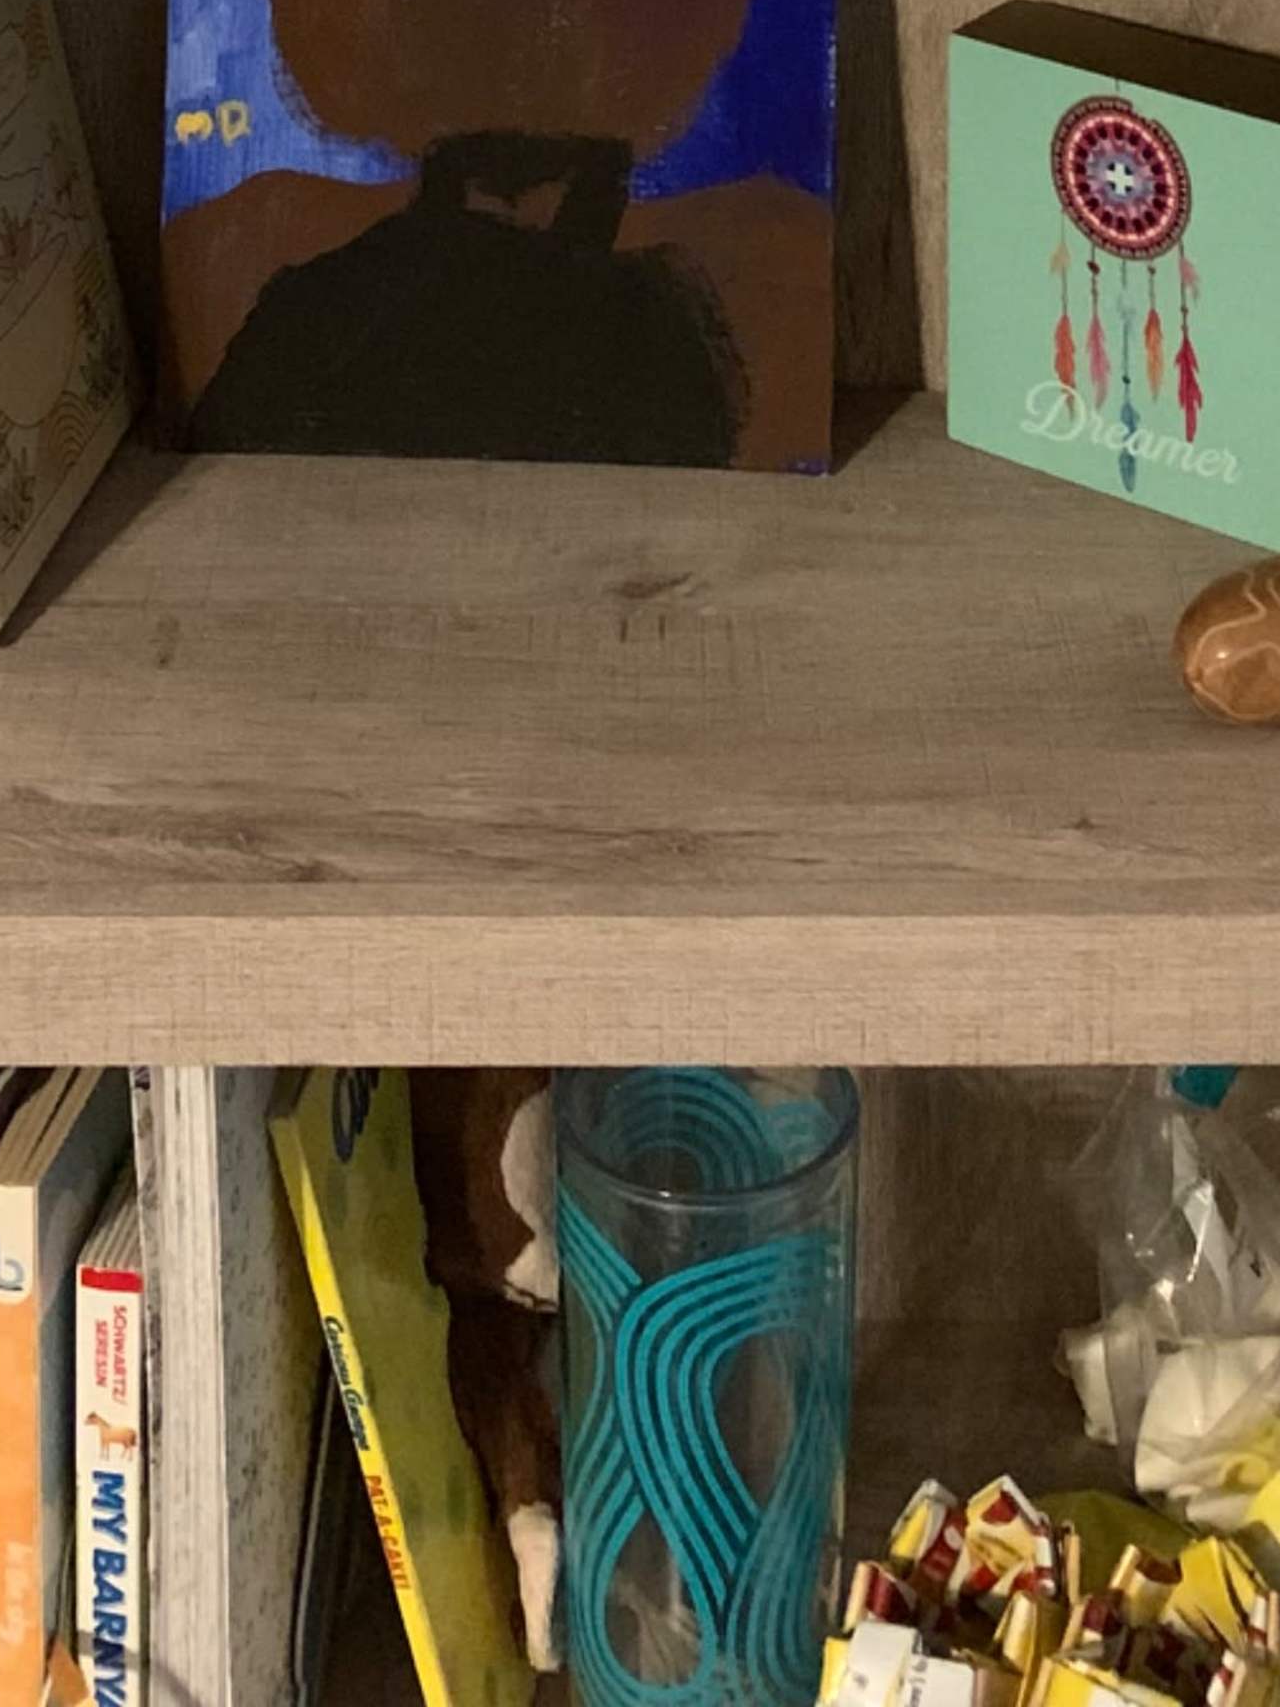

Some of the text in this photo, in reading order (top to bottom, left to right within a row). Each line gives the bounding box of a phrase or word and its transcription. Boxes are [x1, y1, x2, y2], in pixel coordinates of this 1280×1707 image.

[1020, 378, 1244, 485] Dreamer
[111, 1304, 129, 1406] SCHWARTZ/
[91, 1469, 128, 1544] MY
